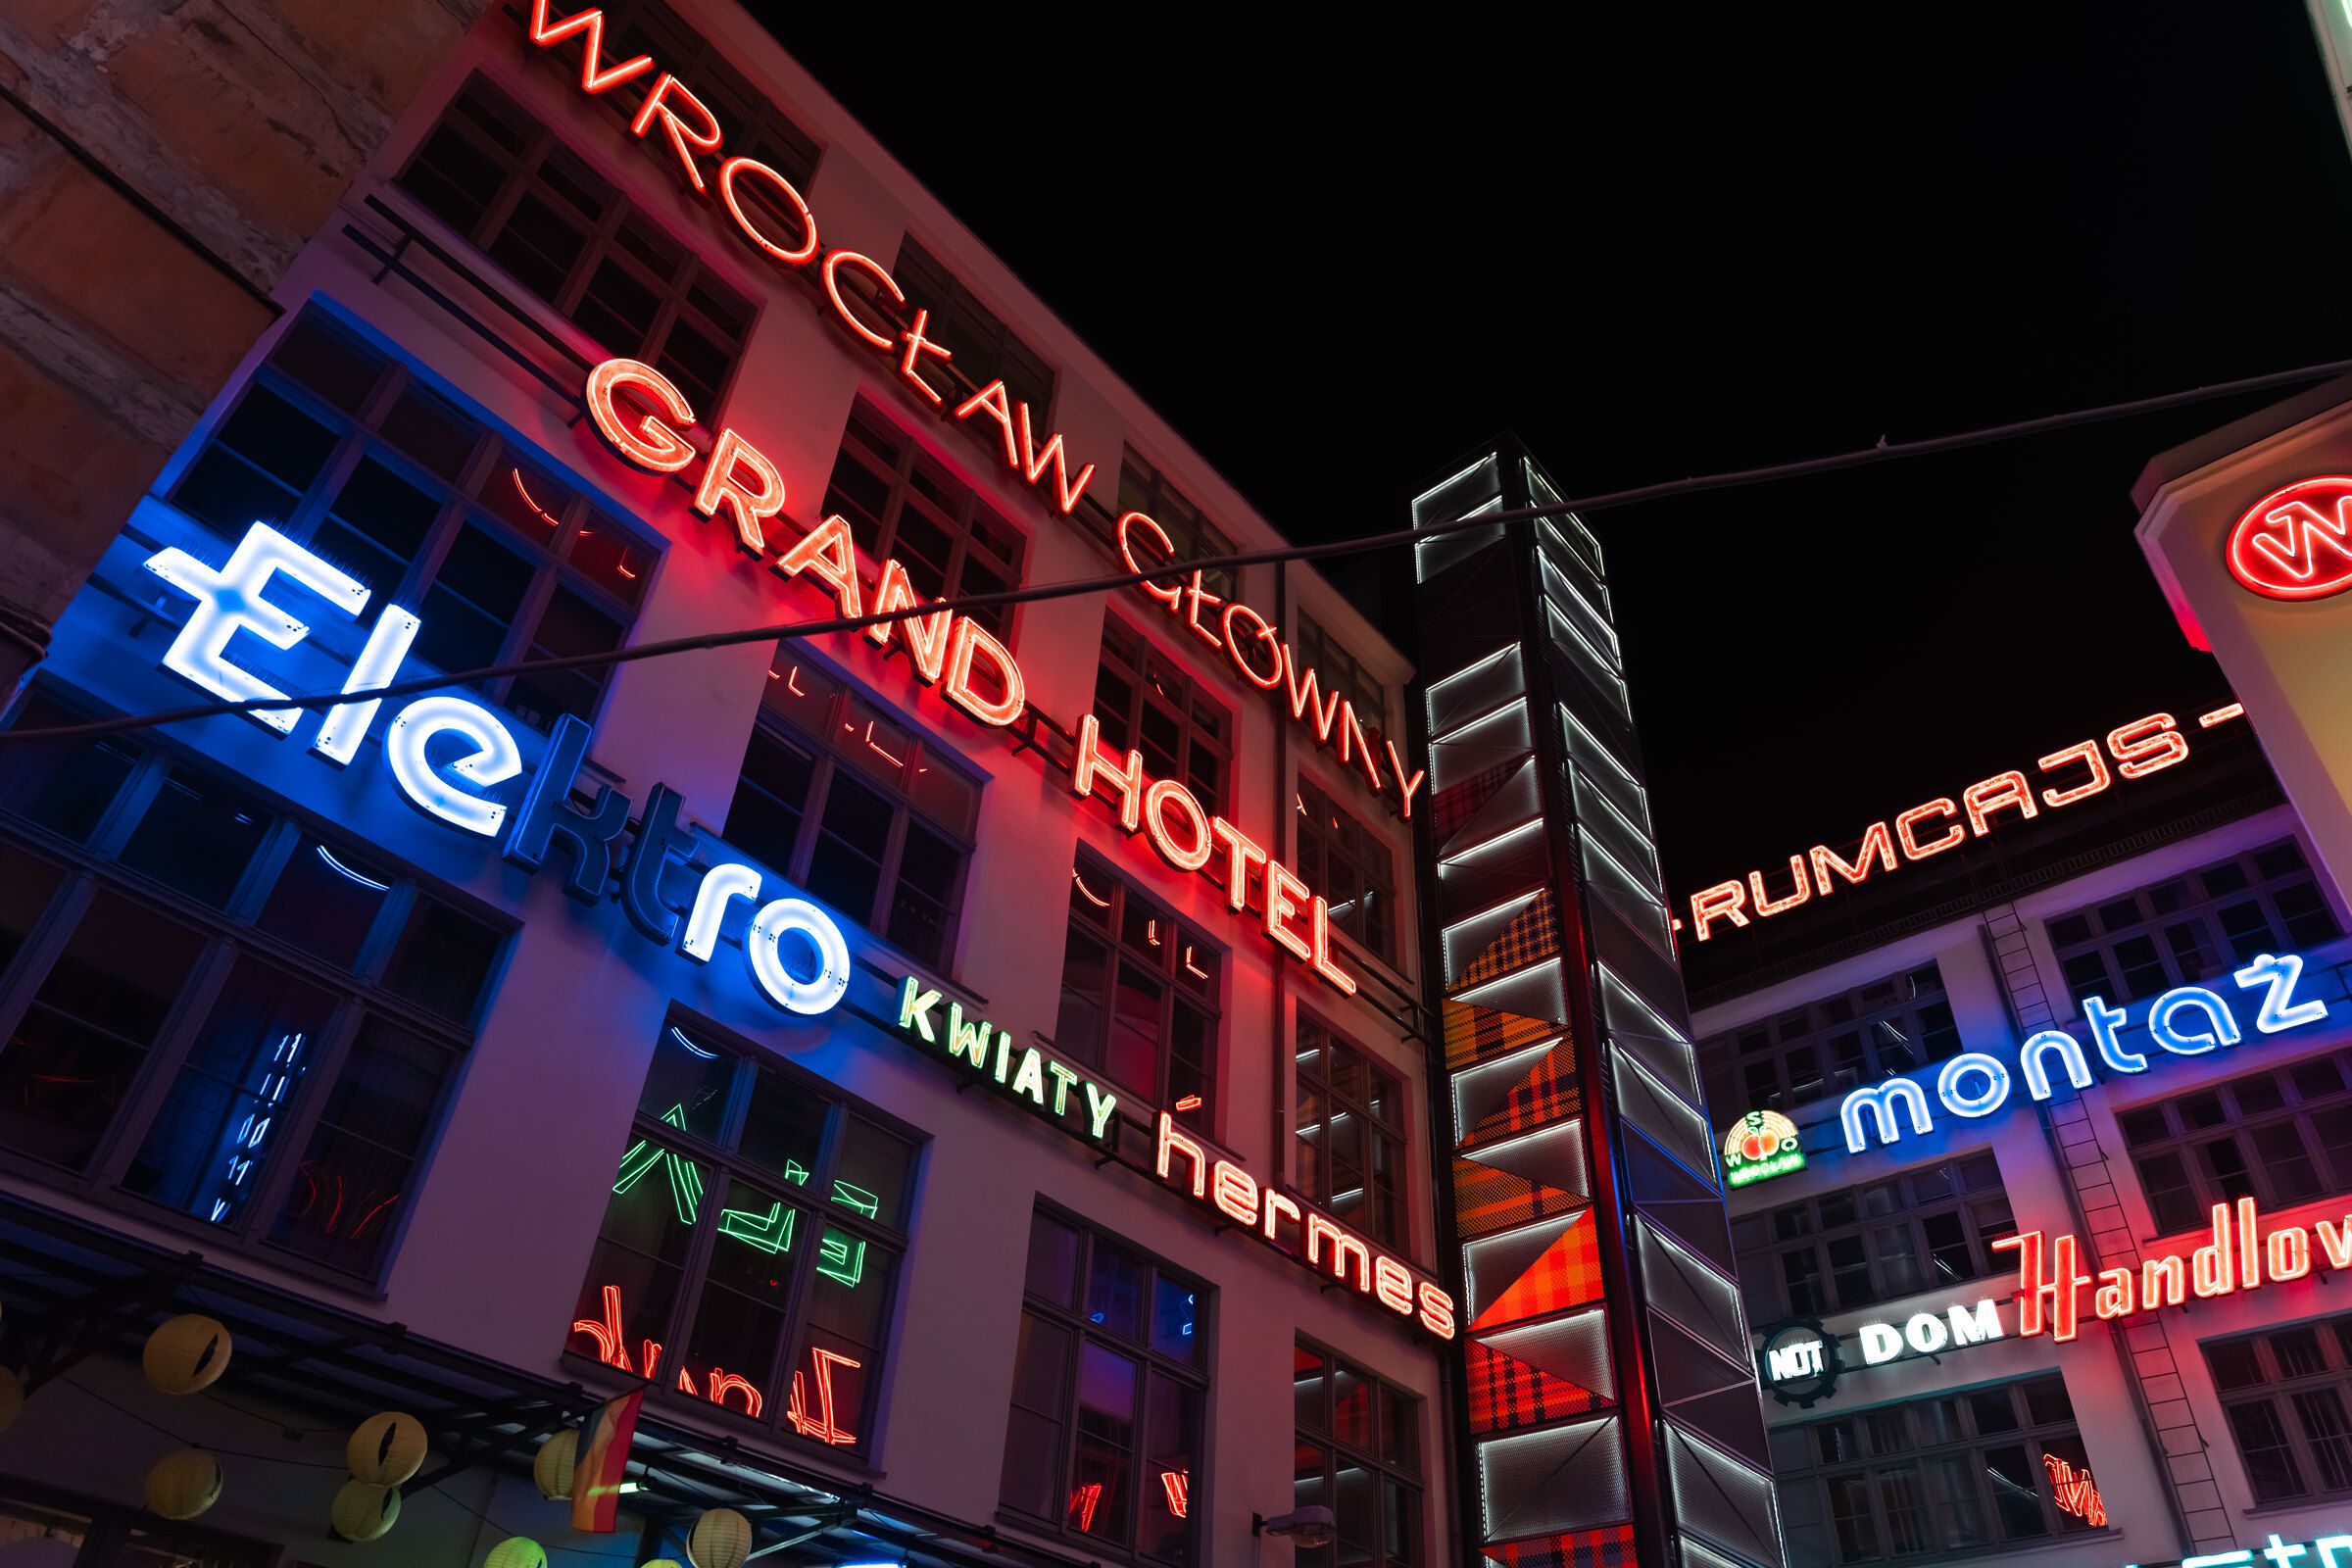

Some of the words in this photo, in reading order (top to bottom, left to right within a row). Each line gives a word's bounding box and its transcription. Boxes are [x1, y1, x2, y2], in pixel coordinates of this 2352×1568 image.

[529, 0, 1096, 516] WROCŁAW
[143, 519, 852, 1016] Elektro
[585, 358, 1025, 728] GRAND
[1073, 713, 1357, 998] HOTEL
[1689, 712, 2189, 942] RUMCAJS
[898, 974, 1117, 1142] KWIATY
[1769, 1340, 1824, 1381] NOT
[1858, 1298, 2005, 1366] DOM
